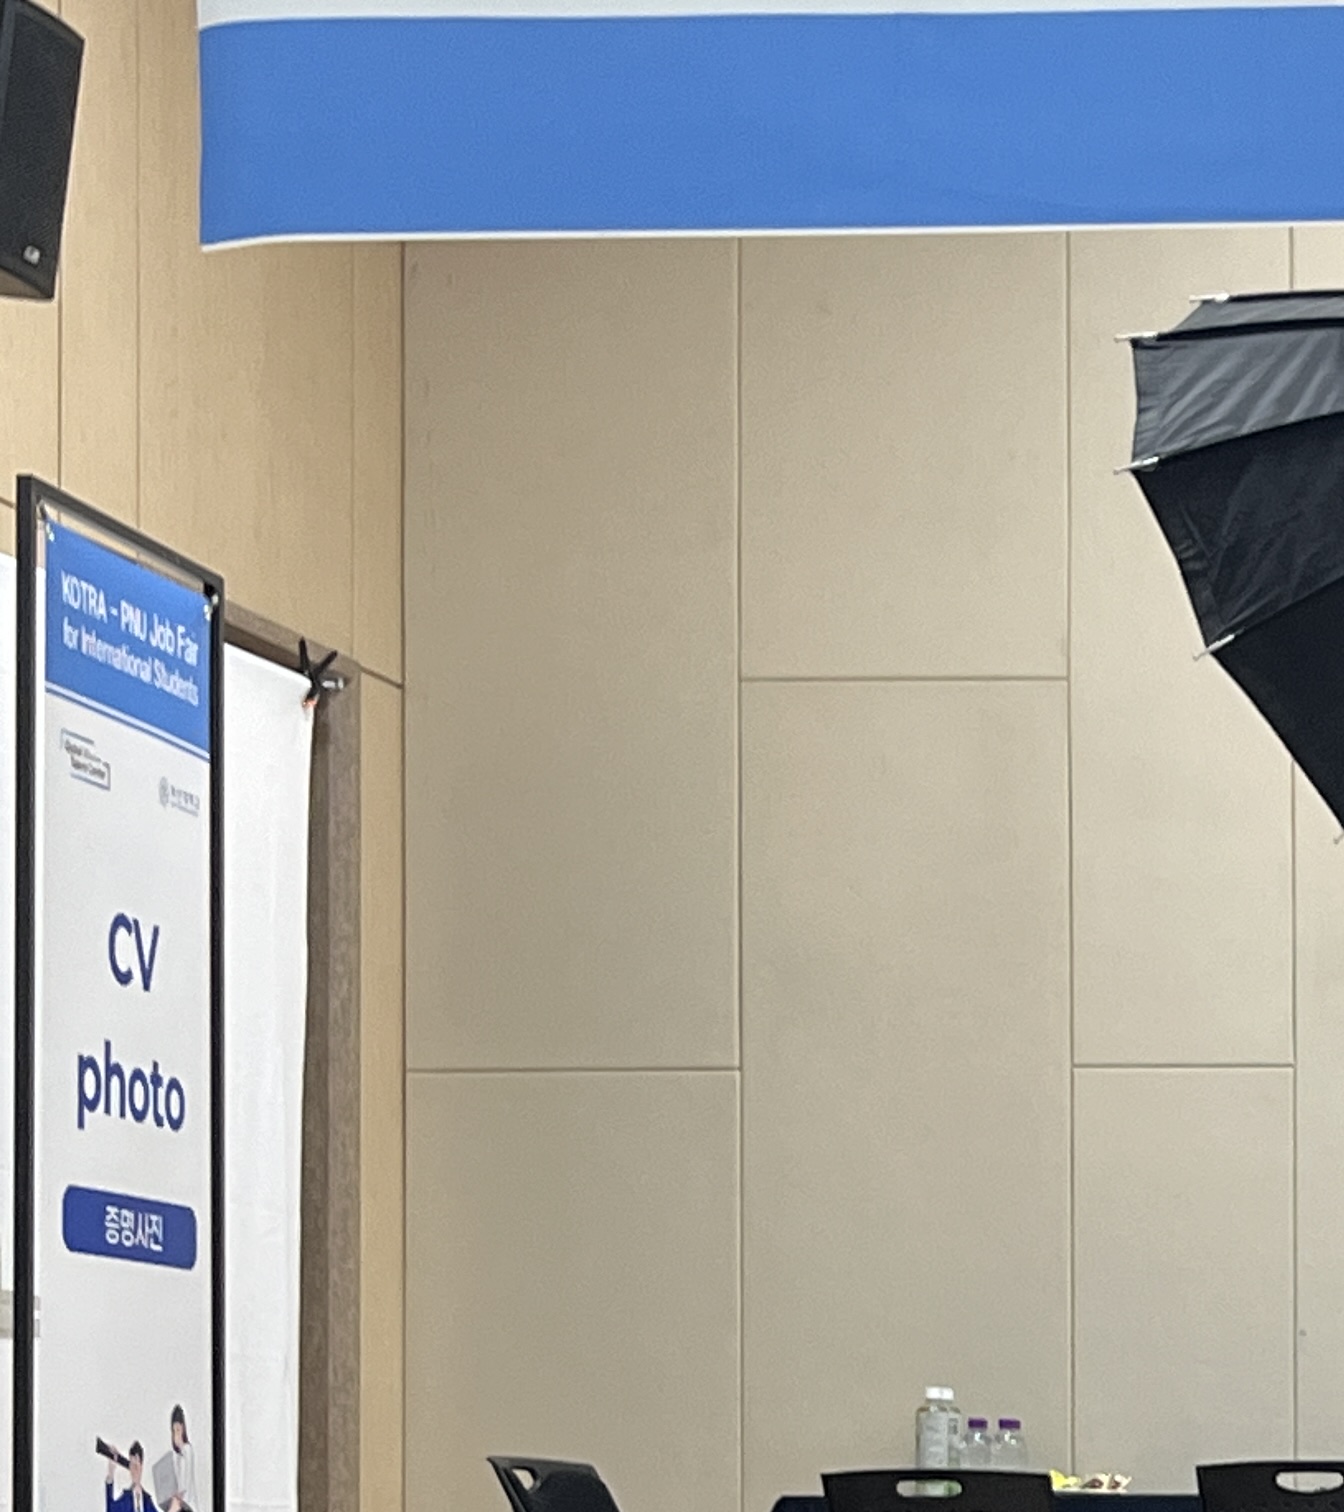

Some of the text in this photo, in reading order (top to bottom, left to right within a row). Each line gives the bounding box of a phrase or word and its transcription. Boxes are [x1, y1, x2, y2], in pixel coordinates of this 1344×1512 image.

[61, 569, 108, 624] KOTRA
[120, 599, 148, 643] PNU
[149, 613, 175, 657] Job
[176, 624, 199, 668] Fair
[62, 616, 199, 707] for International Students
[109, 913, 160, 992] CV
[77, 1038, 186, 1132] photo
[104, 1204, 164, 1252] 증명사진
